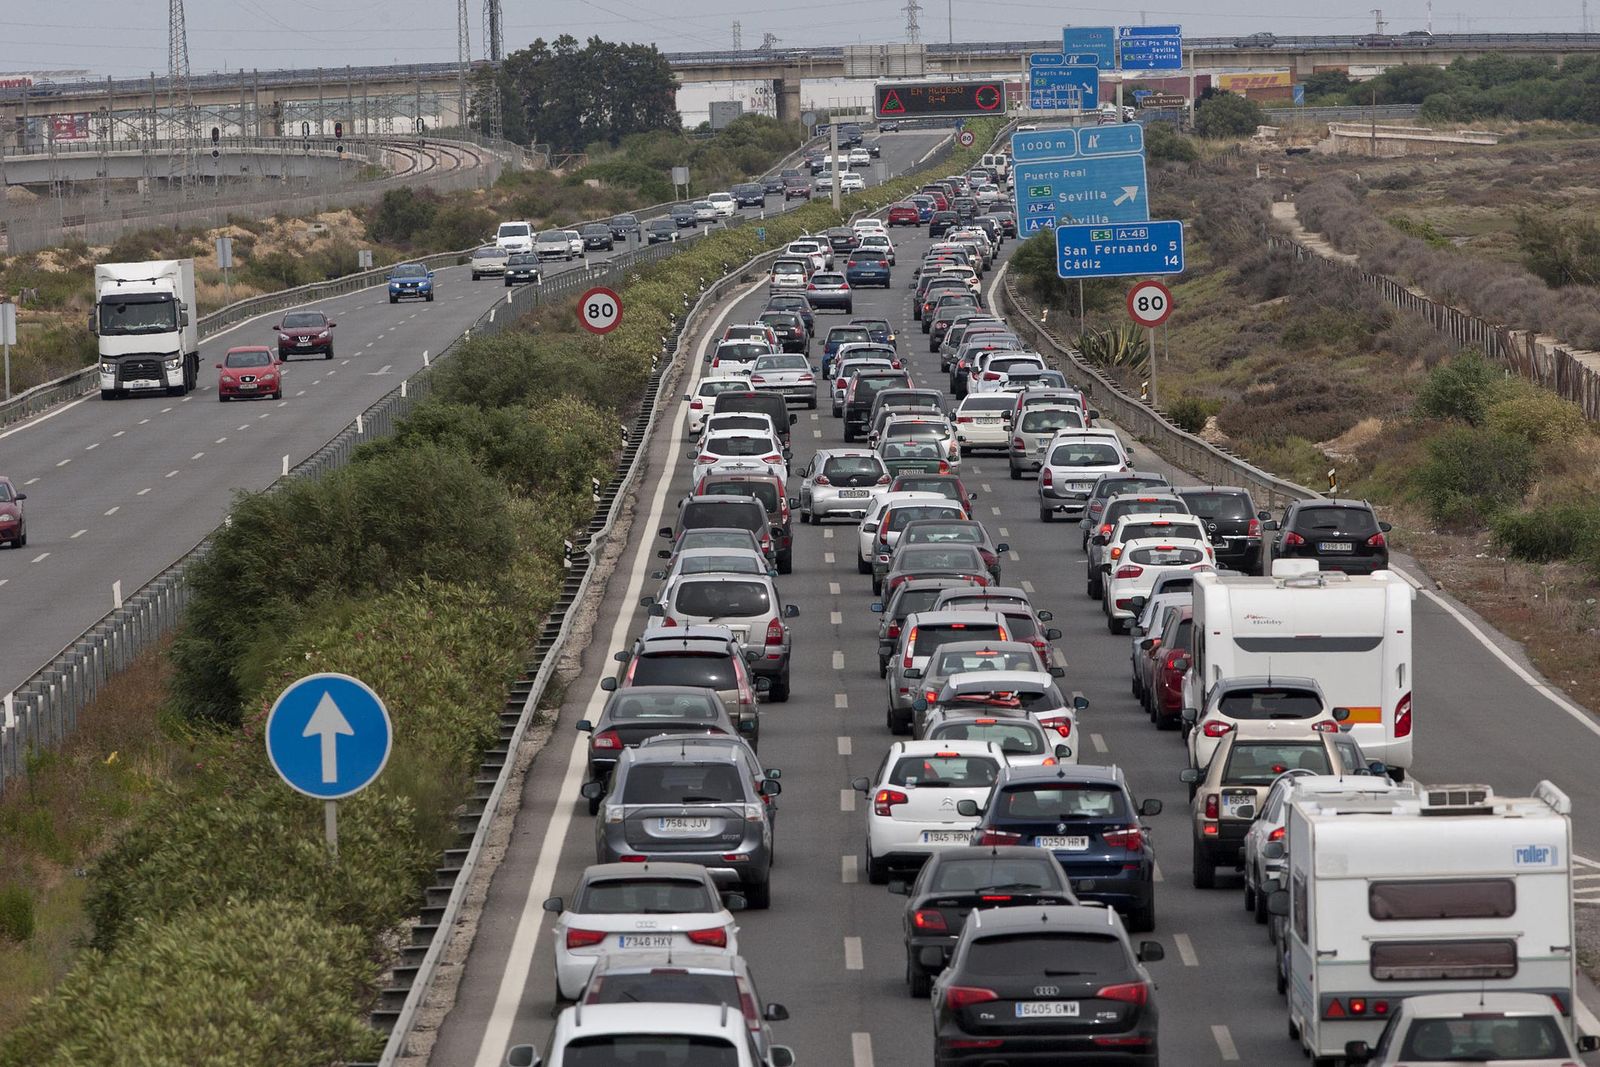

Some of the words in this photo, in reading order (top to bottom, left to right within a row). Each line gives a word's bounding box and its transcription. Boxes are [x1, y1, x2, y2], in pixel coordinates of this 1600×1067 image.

[1050, 83, 1078, 91] Sevilla
[1128, 134, 1134, 143] 1
[1021, 141, 1051, 151] 1000
[1056, 141, 1066, 149] m
[1024, 171, 1060, 180] Puerto
[1063, 168, 1086, 178] Real
[1030, 187, 1051, 197] E-5
[1058, 191, 1107, 203] Sevilla
[1029, 203, 1055, 213] AP-4
[1030, 218, 1054, 230] A-4
[1092, 231, 1111, 240] E-5
[1119, 229, 1146, 239] A-48
[1063, 246, 1087, 256] San
[1094, 243, 1158, 255] Fernando
[1169, 241, 1177, 251] 5
[1064, 259, 1101, 270] Cádiz
[1164, 255, 1179, 266] 14
[1138, 296, 1163, 311] 80
[588, 303, 613, 319] 80
[1229, 795, 1250, 805] 6655
[665, 818, 687, 828] 7584
[690, 818, 707, 828] JJV
[930, 832, 950, 842] 1945
[953, 832, 969, 841] HPN
[1042, 838, 1065, 846] 0250
[1516, 845, 1549, 865] roller
[653, 936, 672, 946] HXV
[1023, 1003, 1051, 1014] 6405
